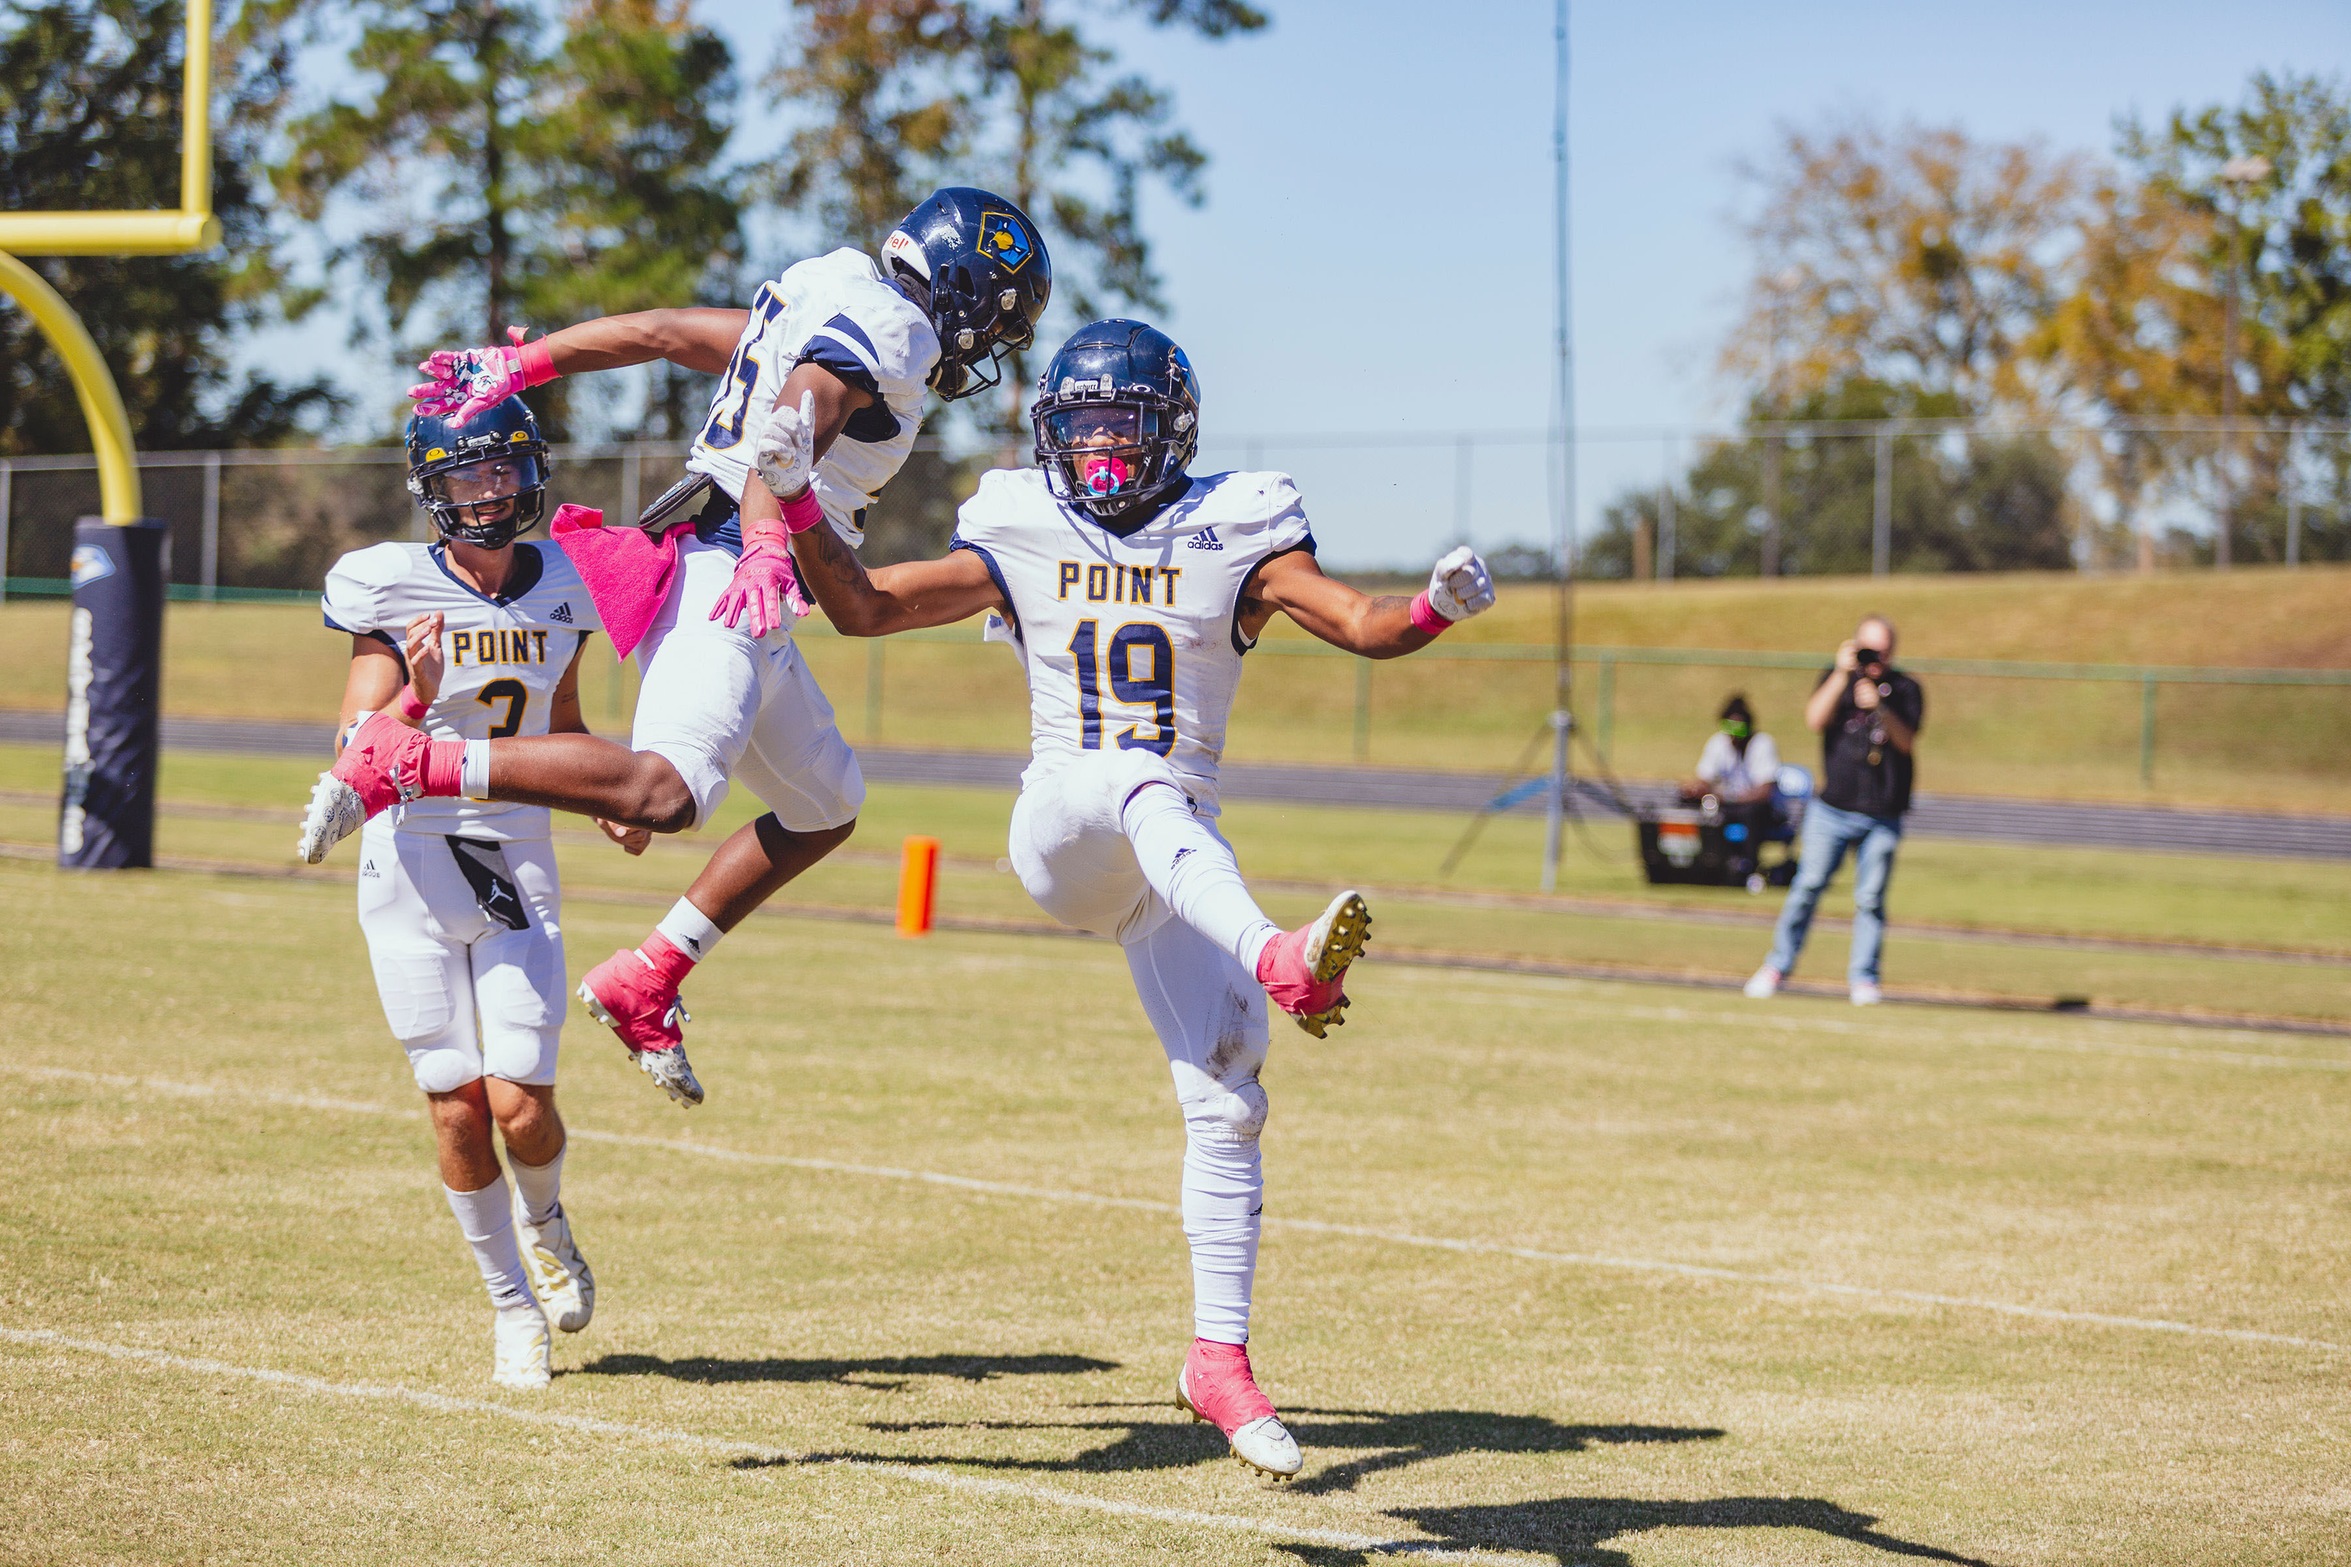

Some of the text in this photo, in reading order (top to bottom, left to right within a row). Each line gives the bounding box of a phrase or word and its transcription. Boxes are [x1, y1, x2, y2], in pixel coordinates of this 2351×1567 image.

[1187, 540, 1225, 551] adidas
[1058, 560, 1183, 608] POINT
[451, 628, 549, 667] POINT
[1065, 618, 1179, 760] 19
